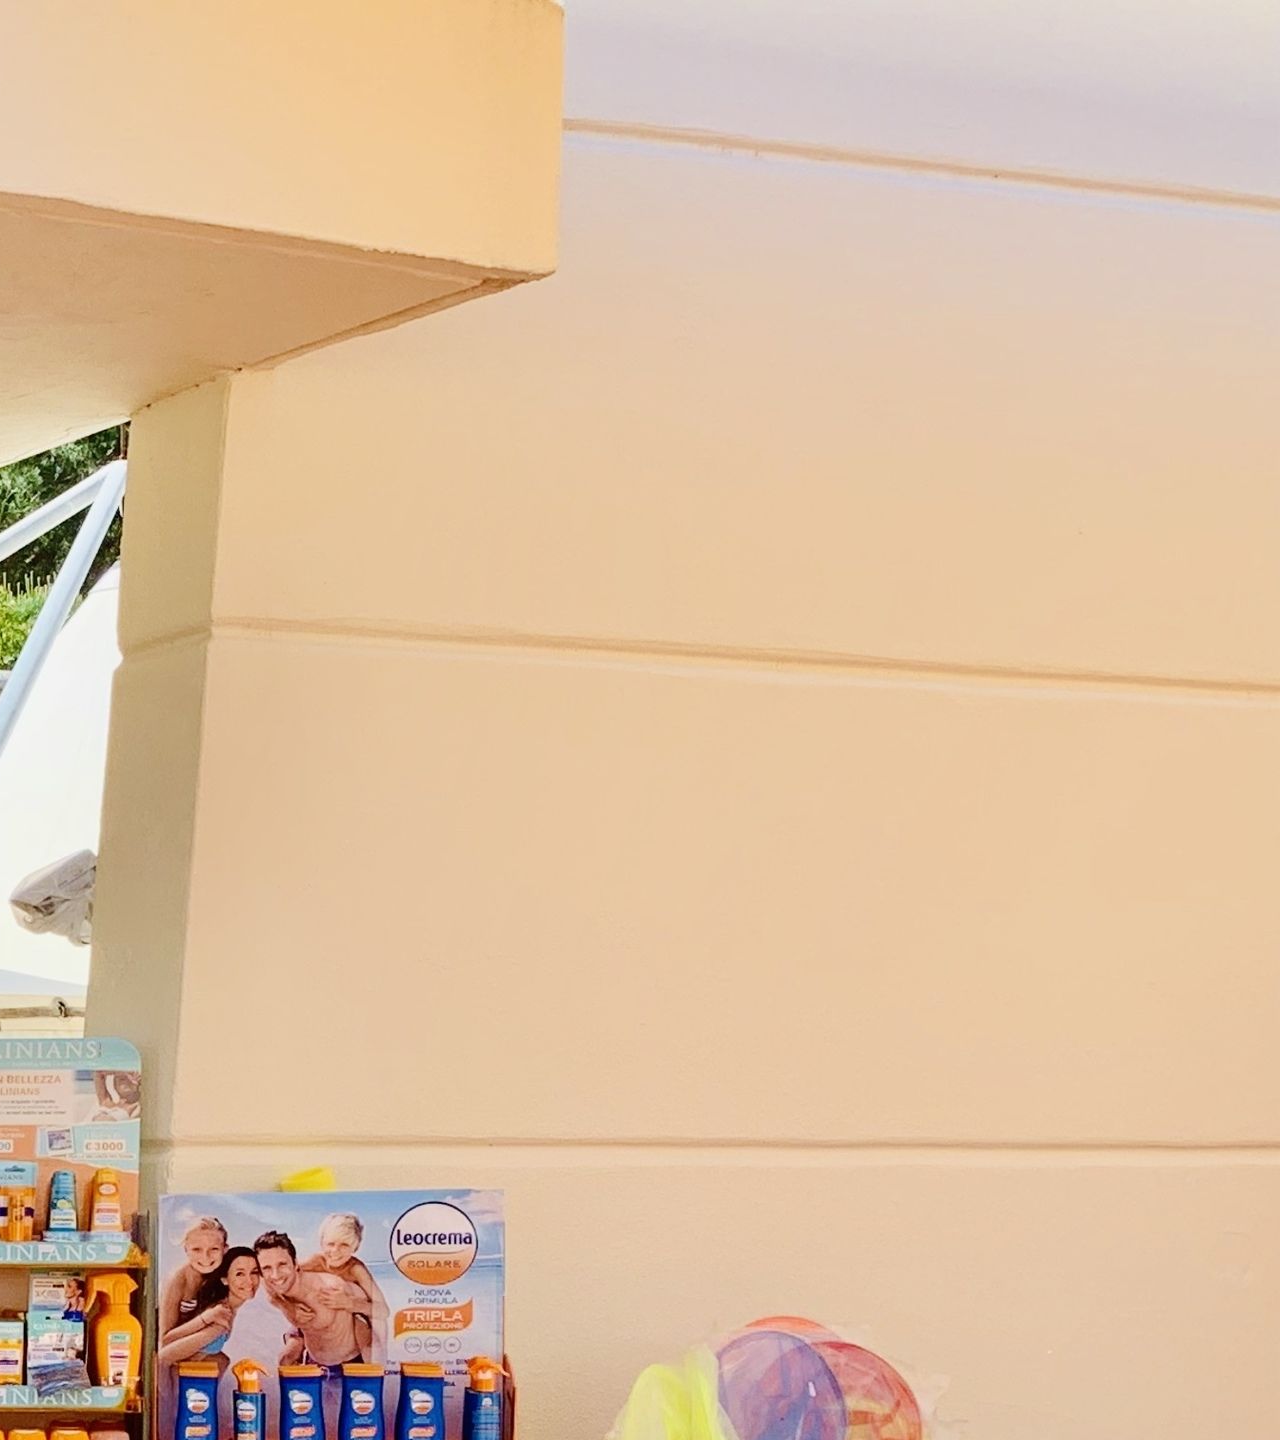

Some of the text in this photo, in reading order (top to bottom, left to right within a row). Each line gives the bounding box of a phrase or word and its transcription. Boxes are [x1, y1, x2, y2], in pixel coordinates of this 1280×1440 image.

[7, 1075, 61, 1085] BELLEZZA
[397, 1229, 472, 1246] Leocrema
[407, 1260, 461, 1268] SOLARE
[403, 1311, 462, 1321] TRIPLA
[403, 1322, 464, 1330] PROTEZIONE
